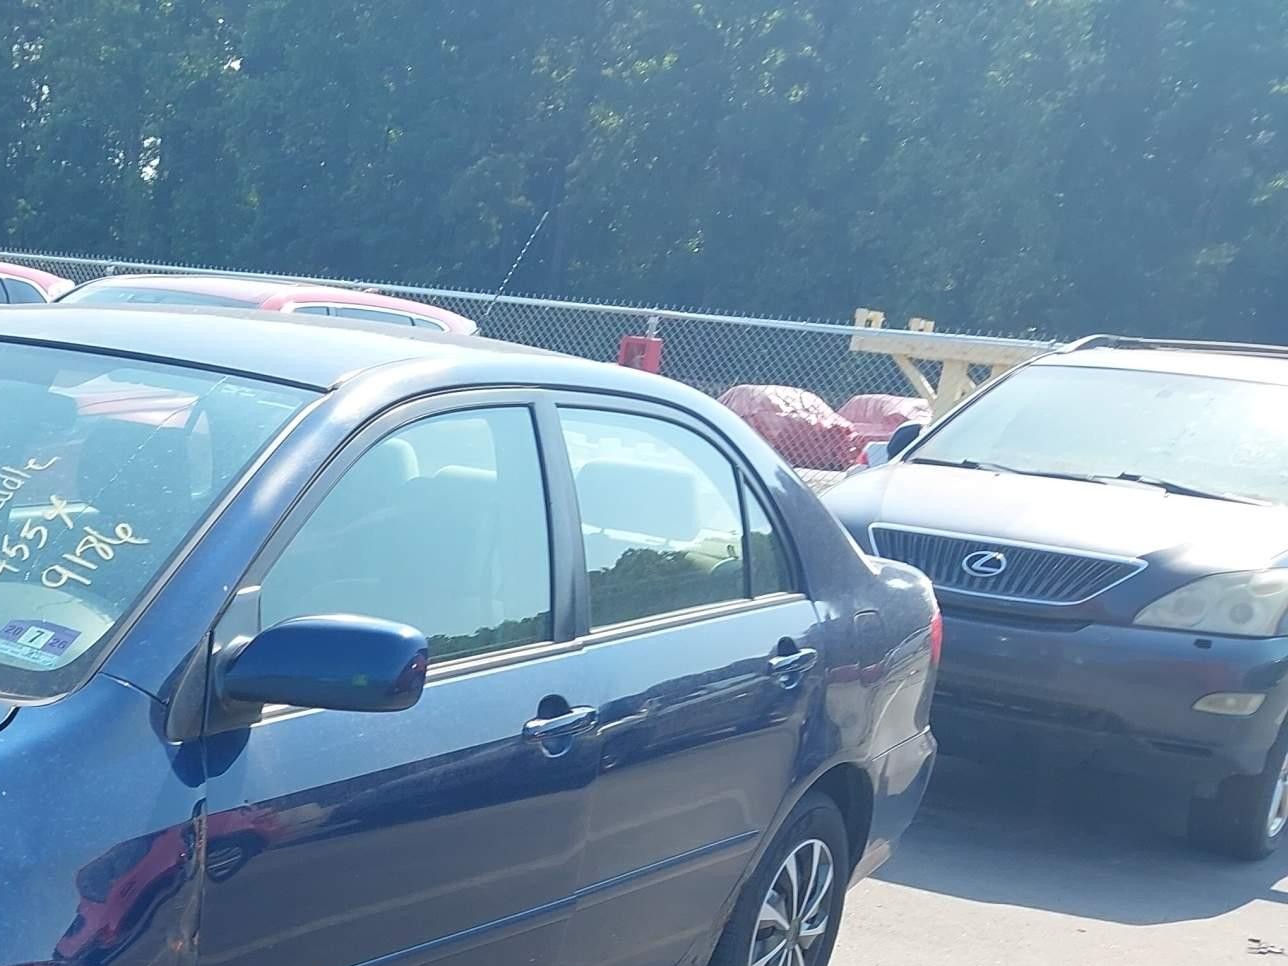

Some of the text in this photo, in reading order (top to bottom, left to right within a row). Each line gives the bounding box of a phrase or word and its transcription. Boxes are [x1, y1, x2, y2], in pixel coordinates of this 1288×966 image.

[40, 522, 151, 588] 9186
[4, 624, 24, 636] 20
[28, 630, 45, 644] 7
